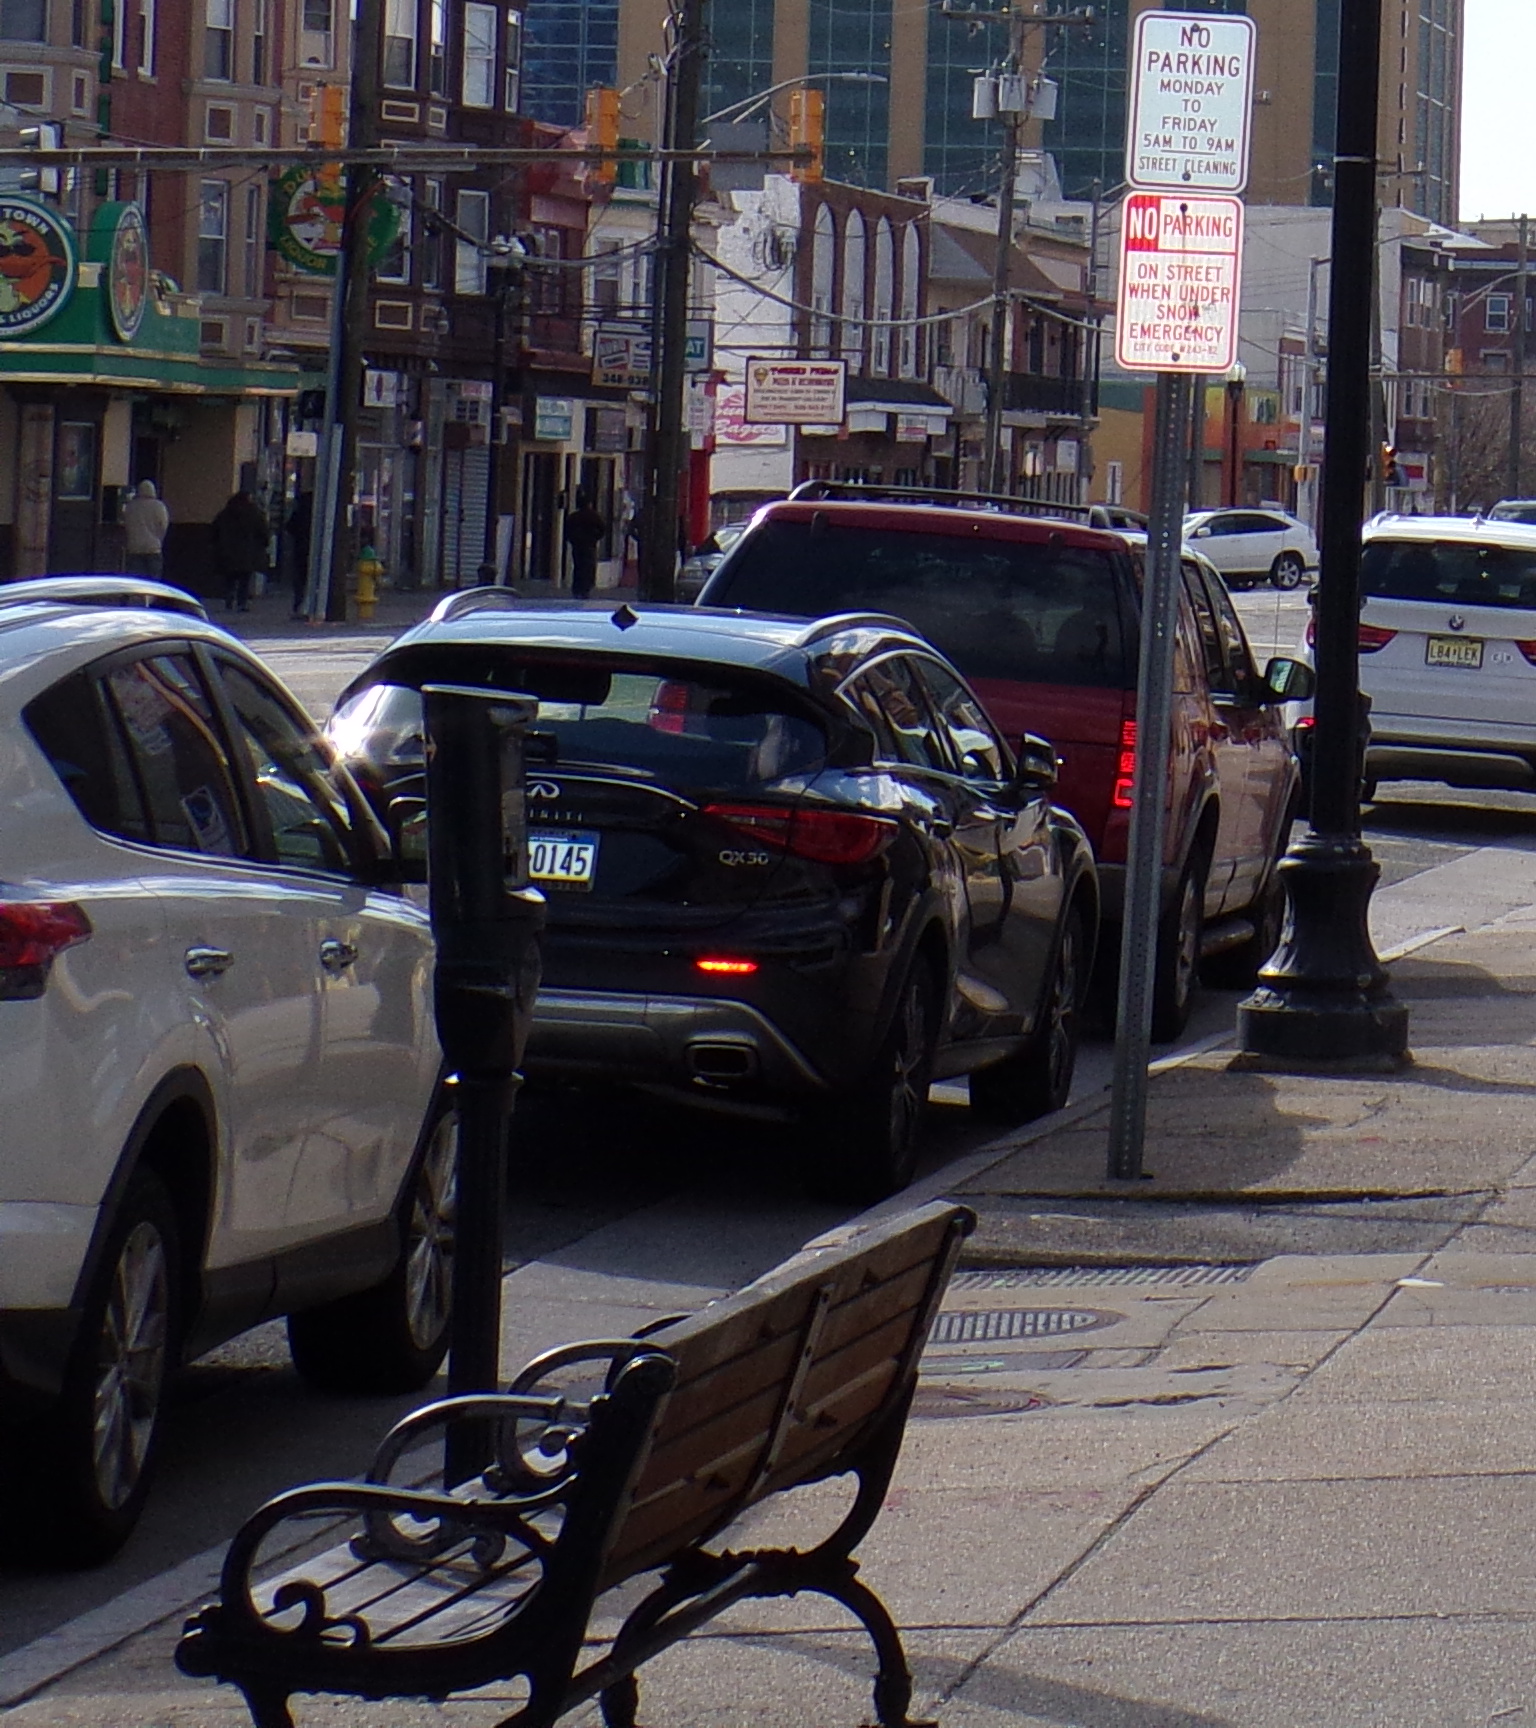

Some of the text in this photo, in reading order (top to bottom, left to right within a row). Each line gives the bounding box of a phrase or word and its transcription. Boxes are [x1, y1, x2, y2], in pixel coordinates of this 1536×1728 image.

[1180, 25, 1211, 48] NO
[1147, 51, 1241, 77] PARKING
[1159, 79, 1225, 95] MONDAY
[1182, 98, 1202, 113] TO
[1161, 116, 1218, 132] FRIDAY
[1143, 133, 1235, 152] 5AM TO 9AM
[1138, 156, 1237, 176] STREET CLEANING
[3, 207, 51, 236] TOWN
[1129, 206, 1233, 240] NO PARKING
[1138, 262, 1223, 283] ON STREET
[1128, 282, 1231, 303] WHEN UNDER
[1156, 304, 1199, 321] SNOW
[1129, 322, 1224, 342] EMERGENCY
[528, 808, 583, 822] INITI
